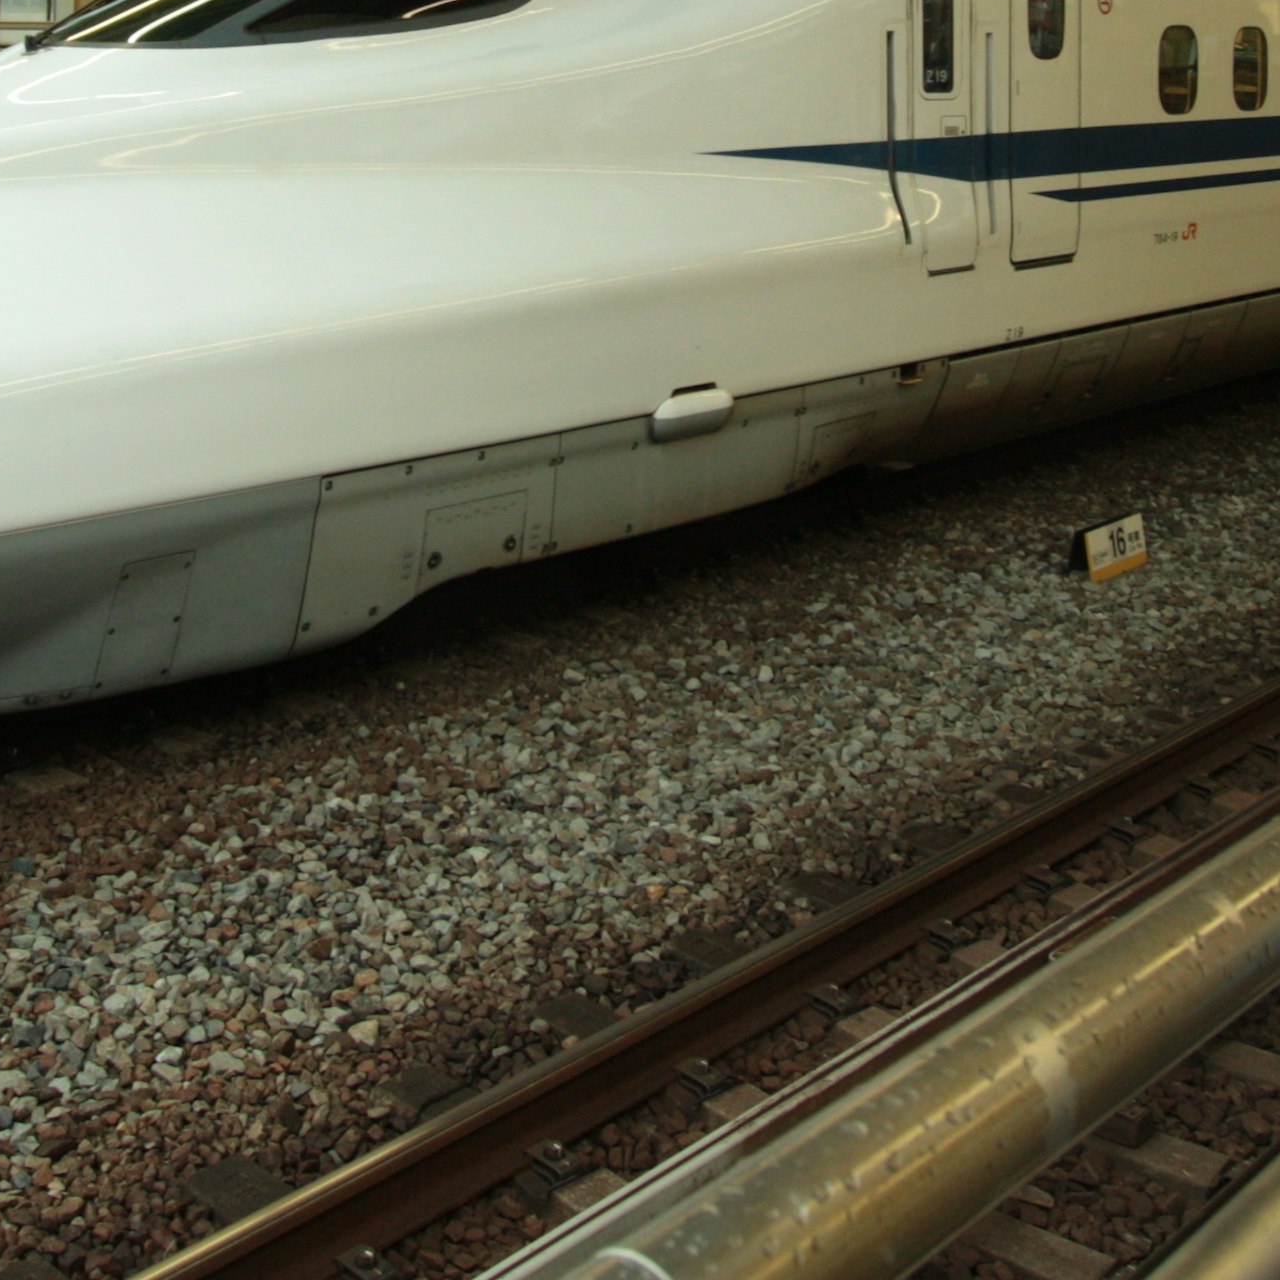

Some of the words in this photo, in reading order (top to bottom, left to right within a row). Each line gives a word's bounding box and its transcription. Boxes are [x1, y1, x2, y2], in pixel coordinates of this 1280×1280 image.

[926, 70, 948, 83] Z19
[1181, 222, 1197, 241] JR
[1109, 527, 1127, 559] 16
